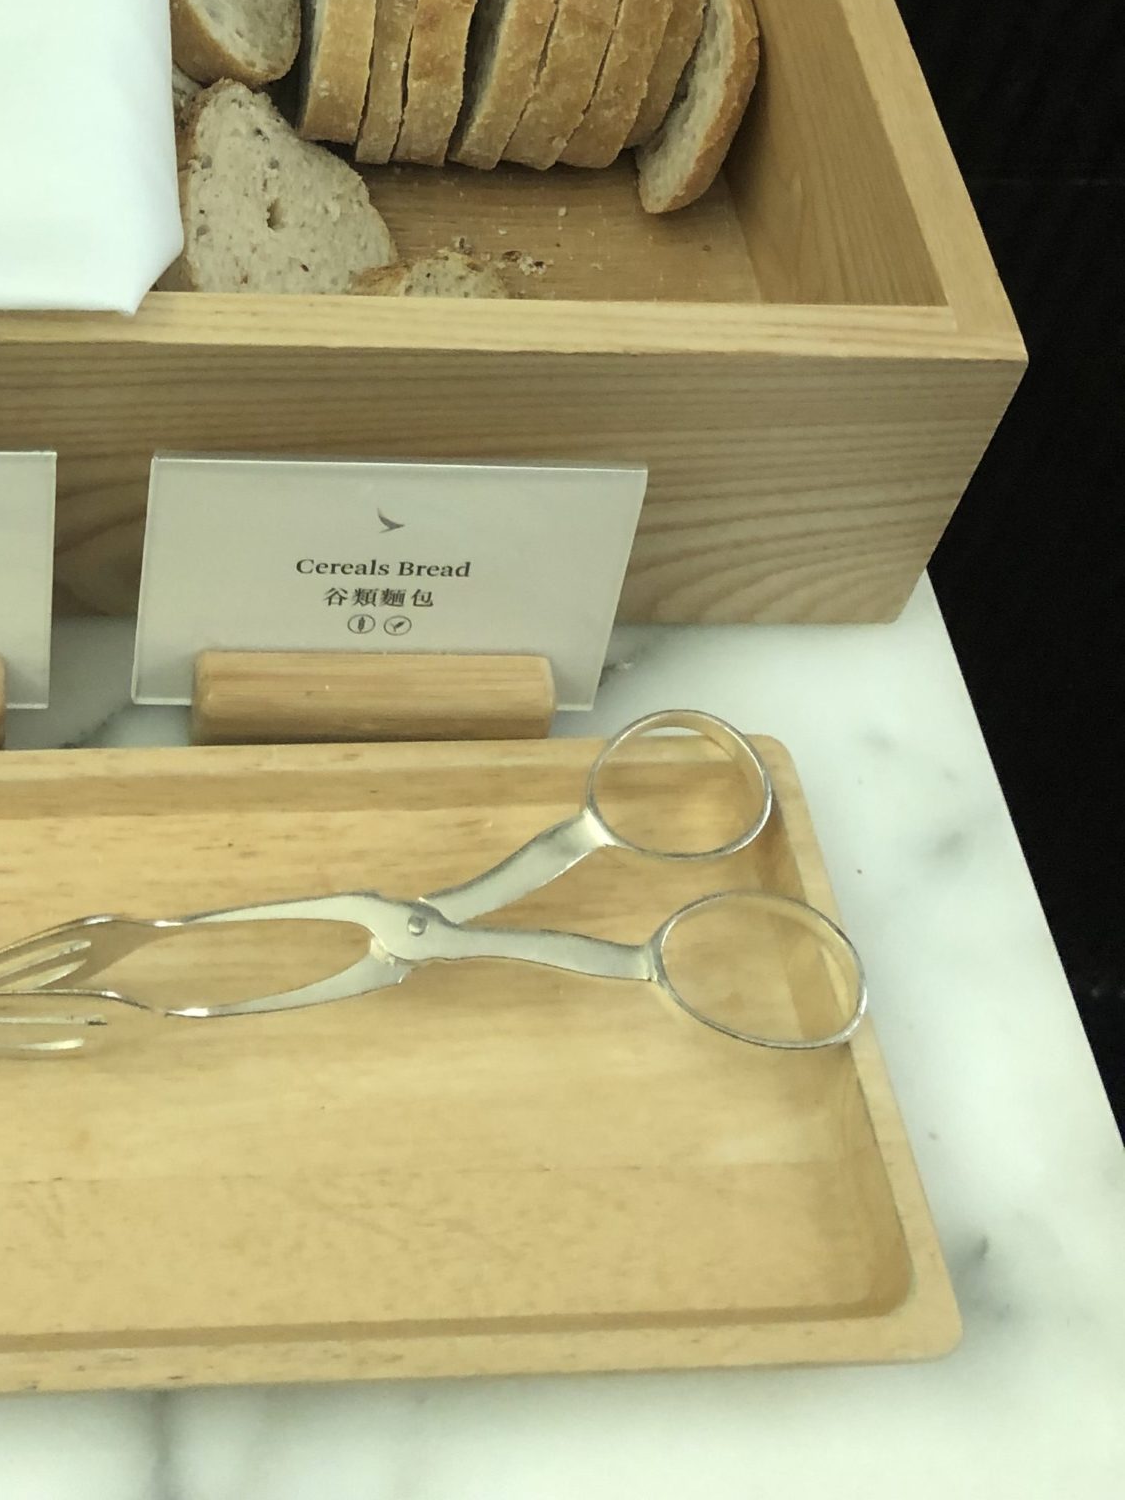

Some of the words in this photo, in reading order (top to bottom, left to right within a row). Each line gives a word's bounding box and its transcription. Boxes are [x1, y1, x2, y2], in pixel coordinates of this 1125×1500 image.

[295, 558, 390, 577] Cereals
[397, 560, 472, 578] Bread
[323, 586, 435, 609] 谷類麵包
